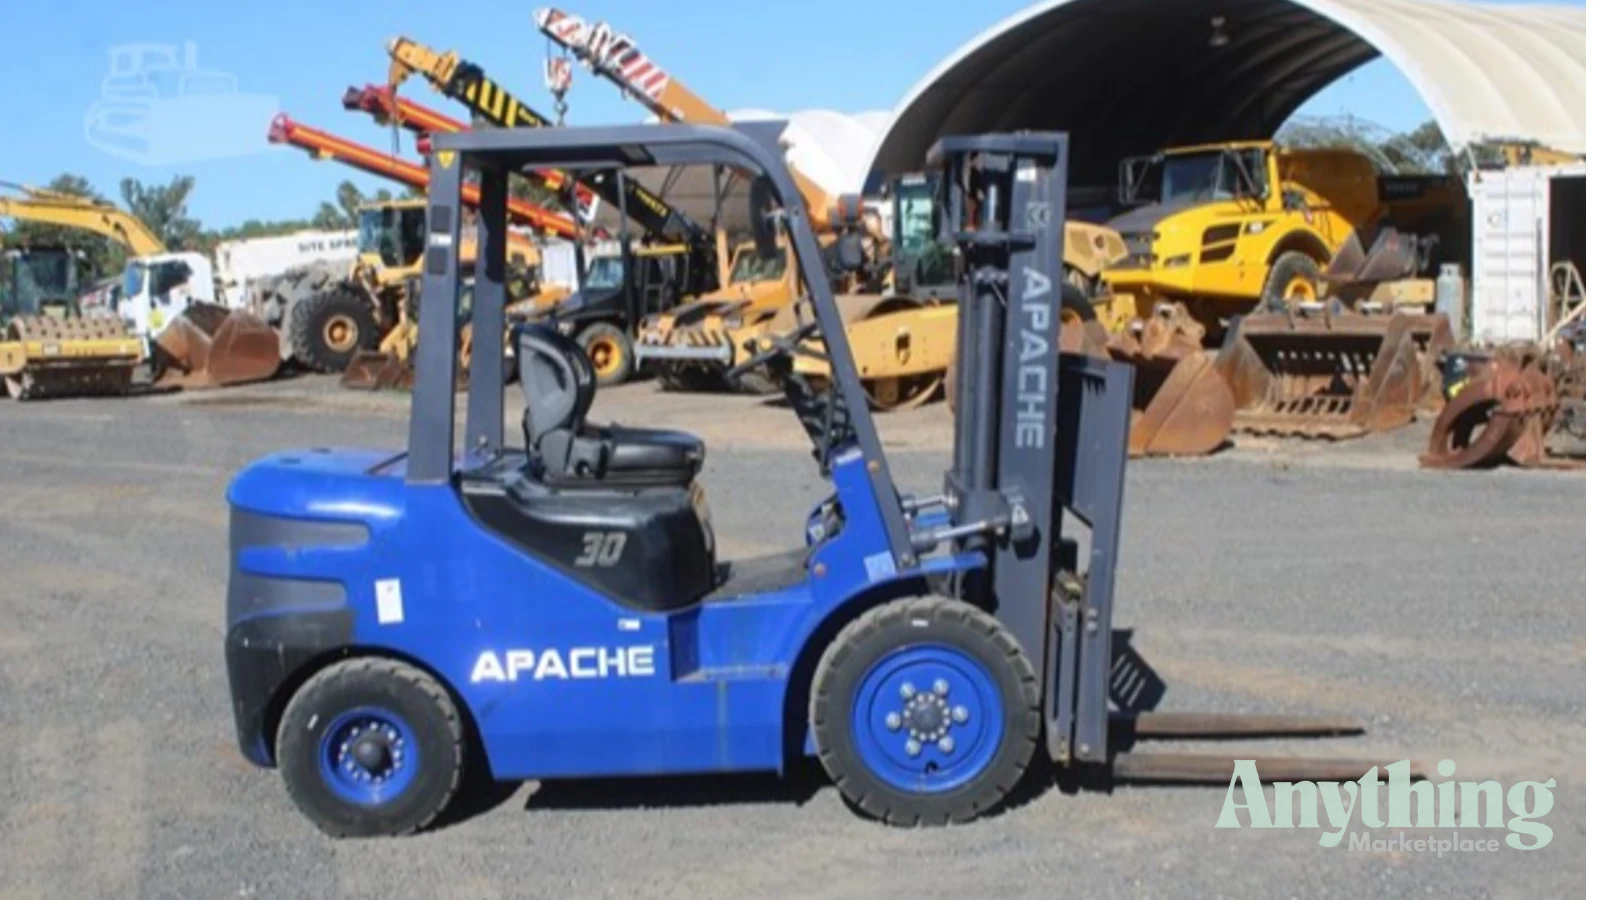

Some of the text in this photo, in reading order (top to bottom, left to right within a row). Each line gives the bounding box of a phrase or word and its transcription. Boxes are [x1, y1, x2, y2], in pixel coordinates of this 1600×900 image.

[1015, 267, 1052, 449] APACHE
[574, 531, 627, 567] 30
[470, 645, 655, 683] APACHE
